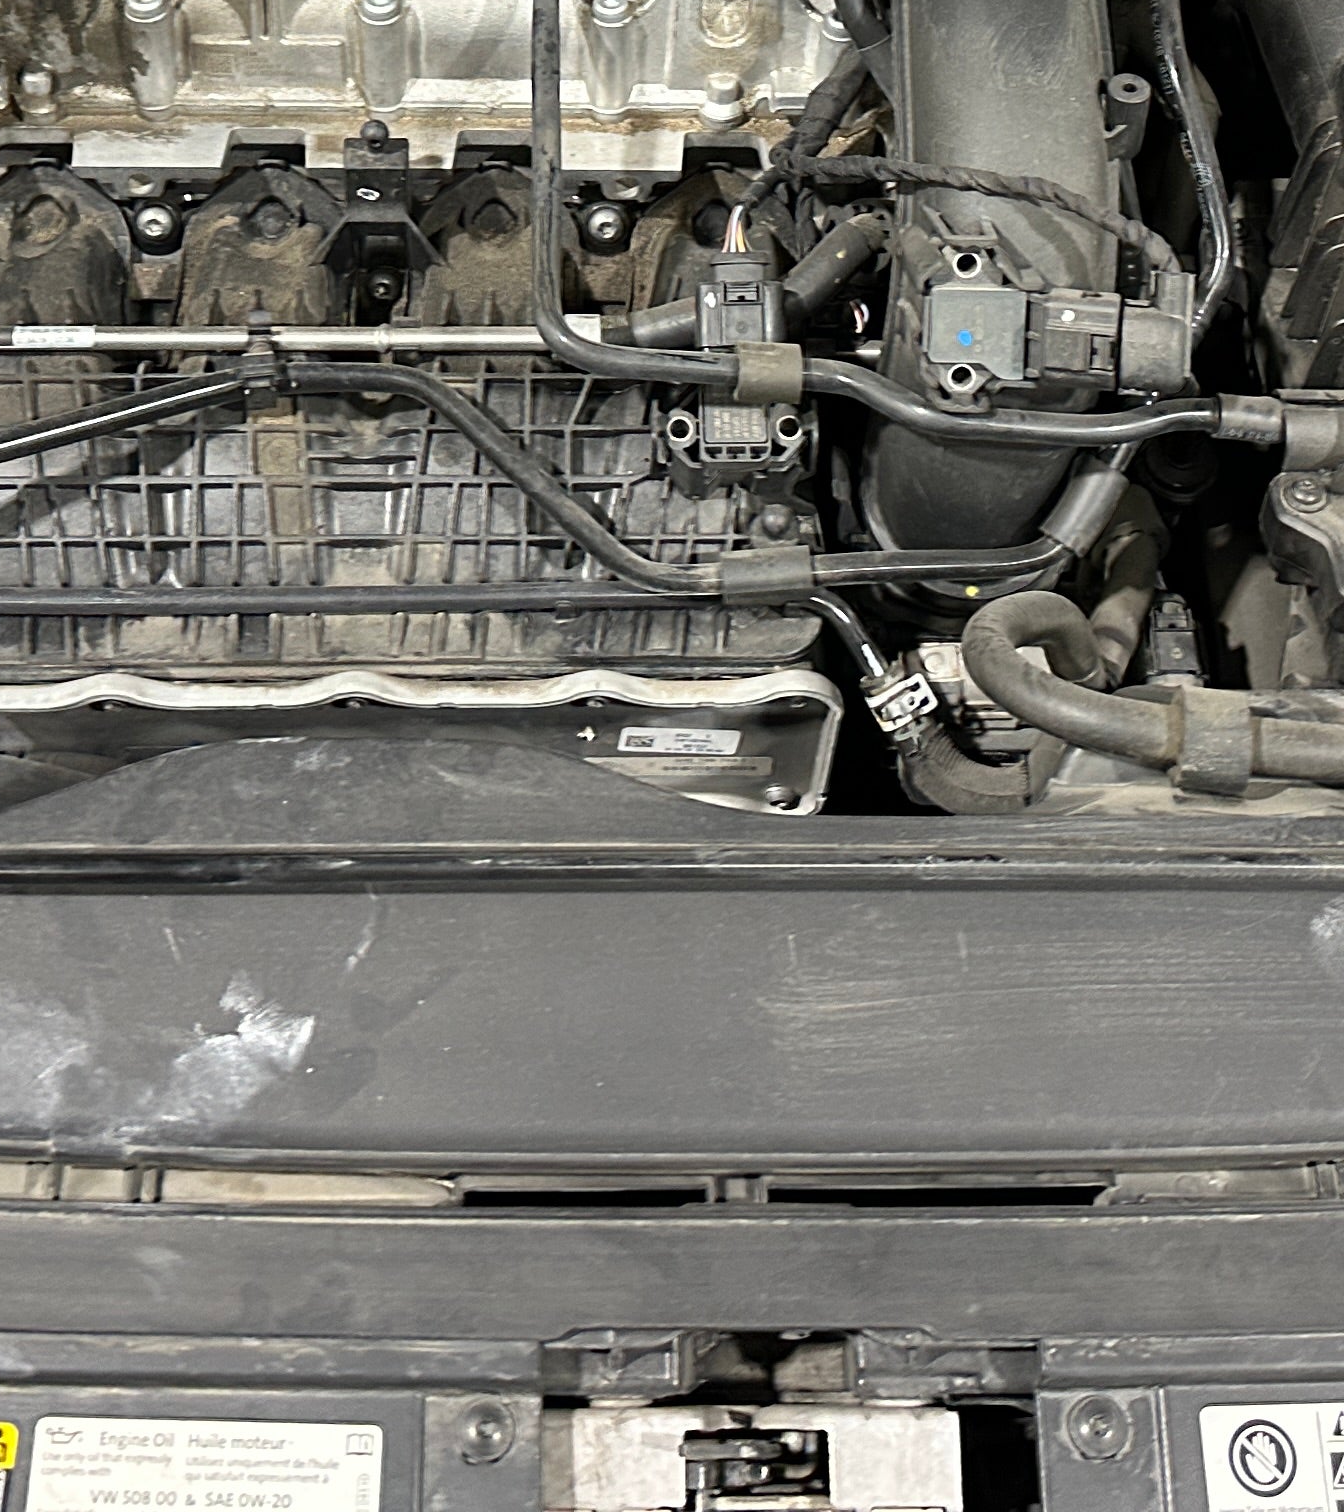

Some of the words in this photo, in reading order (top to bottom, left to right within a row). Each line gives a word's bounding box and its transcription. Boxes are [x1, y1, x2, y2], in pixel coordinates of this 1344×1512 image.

[99, 1431, 150, 1450] Engine
[153, 1433, 175, 1447] Oil
[205, 1491, 234, 1507] SAE
[238, 1492, 292, 1508] 0W-20
